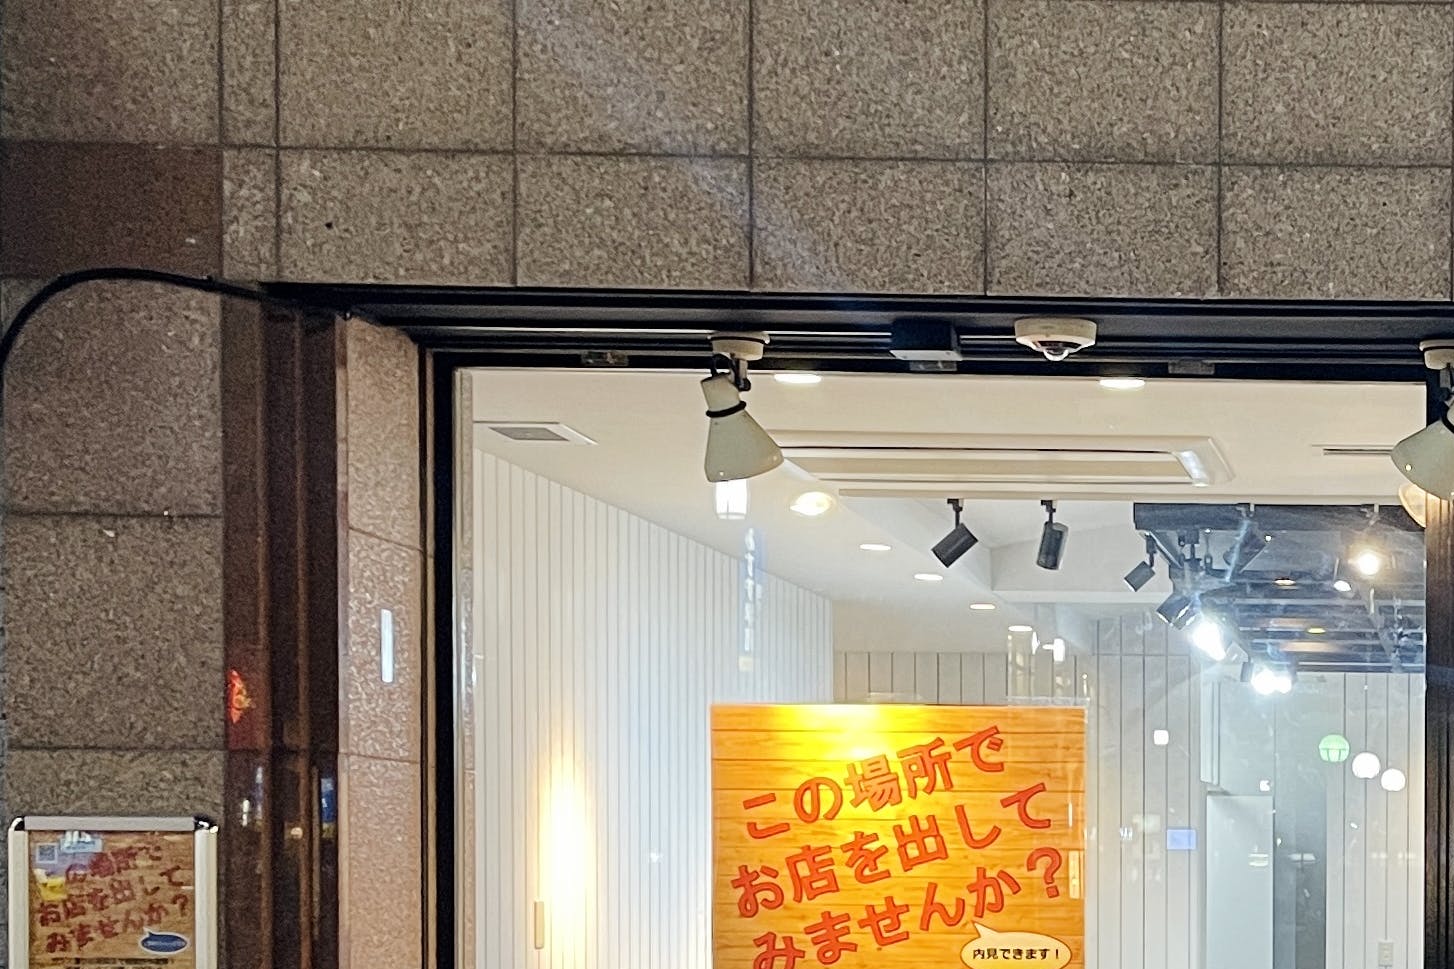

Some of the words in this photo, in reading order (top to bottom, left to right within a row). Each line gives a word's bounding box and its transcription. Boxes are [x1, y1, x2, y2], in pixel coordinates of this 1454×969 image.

[743, 724, 1005, 840] この場所で
[731, 782, 1052, 918] お店を出して
[971, 947, 1060, 961] 内見できます！
